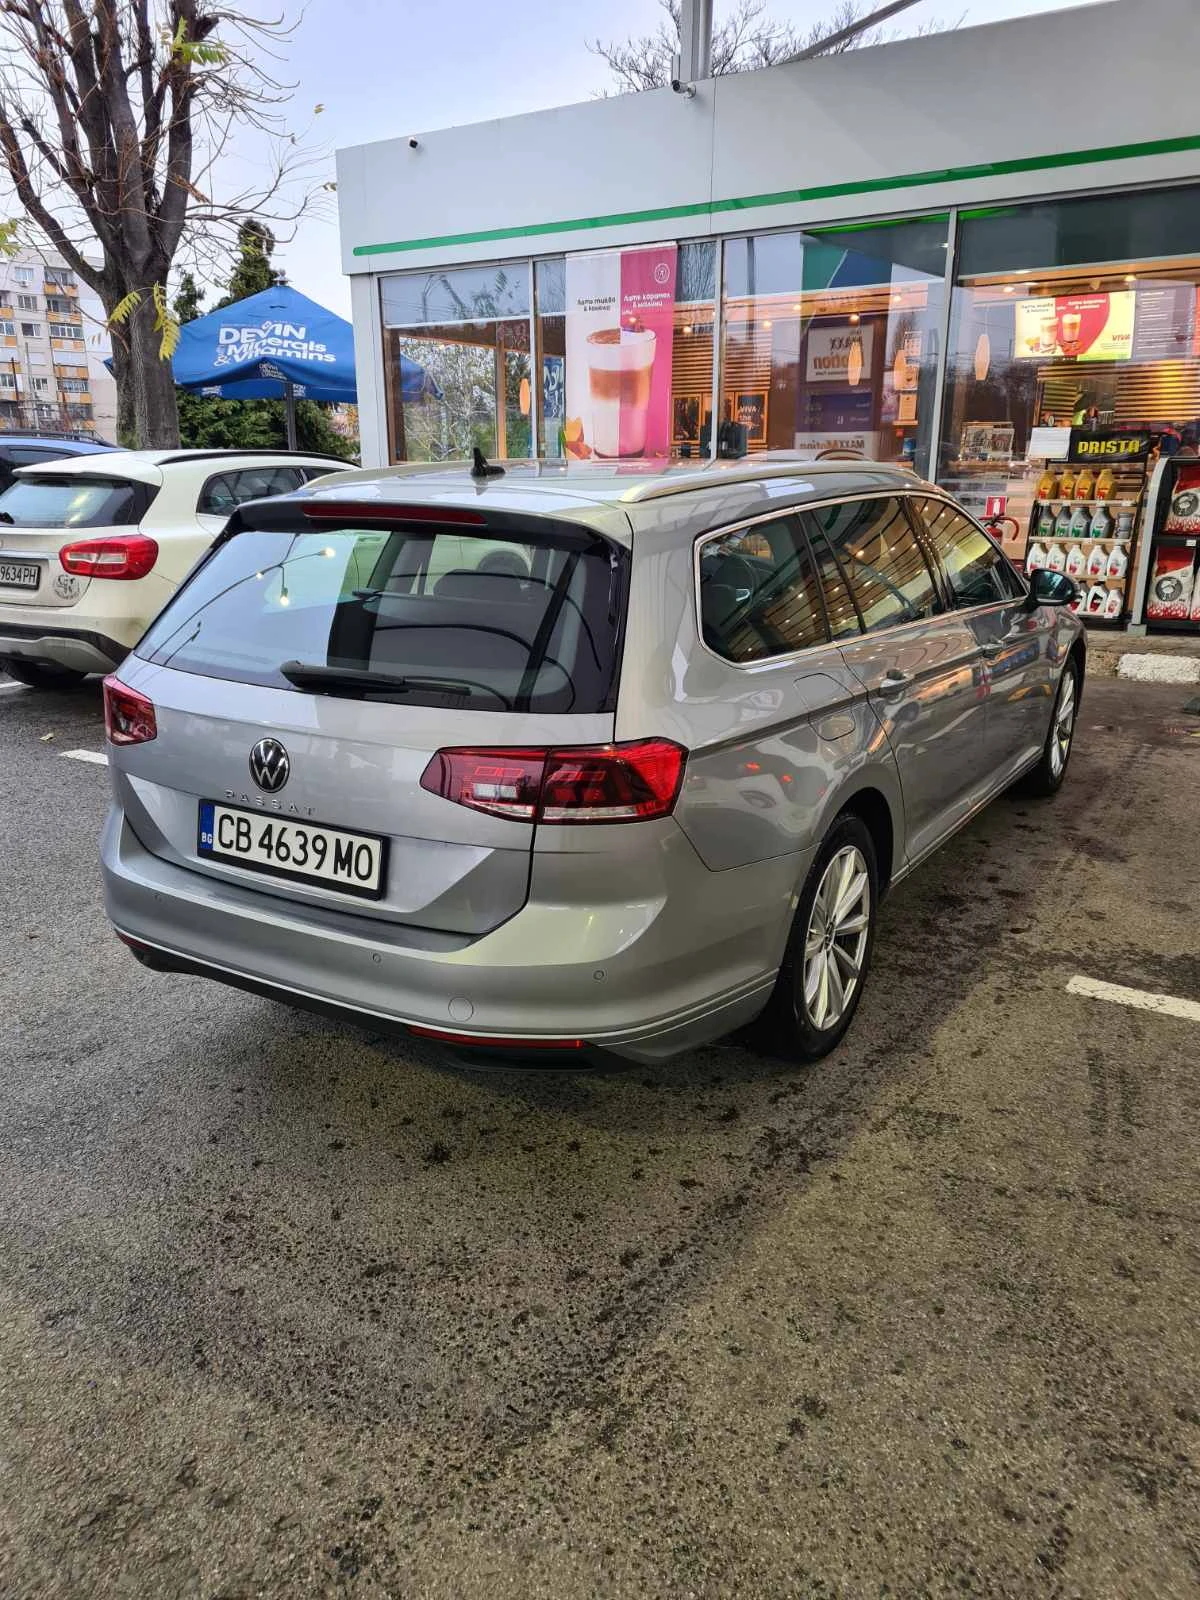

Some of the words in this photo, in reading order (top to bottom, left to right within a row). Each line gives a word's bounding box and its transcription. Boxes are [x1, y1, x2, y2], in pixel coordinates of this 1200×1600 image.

[219, 321, 306, 345] DEVIN
[227, 337, 327, 357] Minerals
[230, 344, 337, 363] Vitamins
[1077, 439, 1141, 454] PRISTA
[0, 566, 21, 582] 9634
[23, 567, 37, 583] PH
[225, 789, 315, 816] PASSAT
[201, 832, 213, 844] BG
[218, 813, 252, 852] CB
[258, 823, 328, 870] 4639
[333, 838, 373, 881] MO
